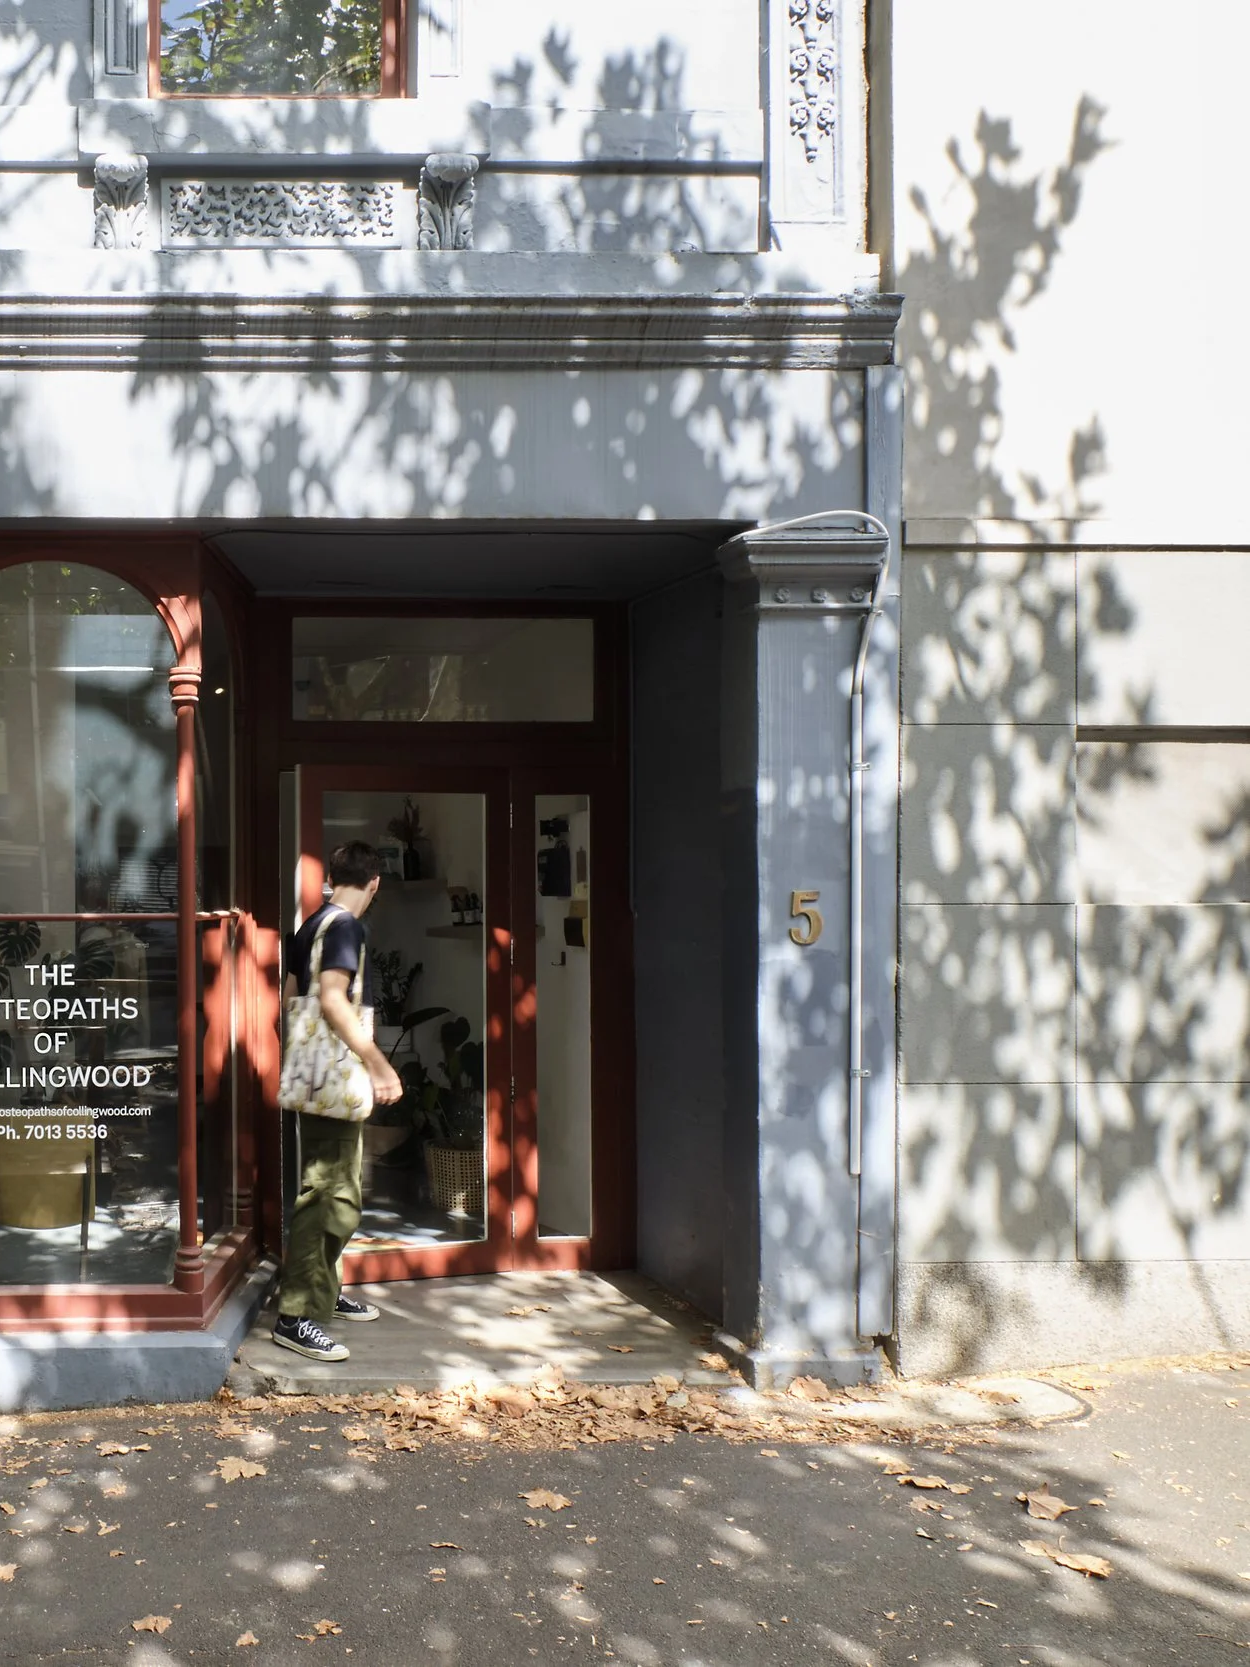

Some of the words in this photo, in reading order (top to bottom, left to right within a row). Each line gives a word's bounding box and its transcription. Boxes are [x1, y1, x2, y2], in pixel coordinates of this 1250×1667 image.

[789, 890, 823, 946] 5
[24, 964, 76, 986] THE
[33, 1032, 68, 1054] OF
[24, 1125, 62, 1140] 7013
[65, 1124, 108, 1140] 5536
